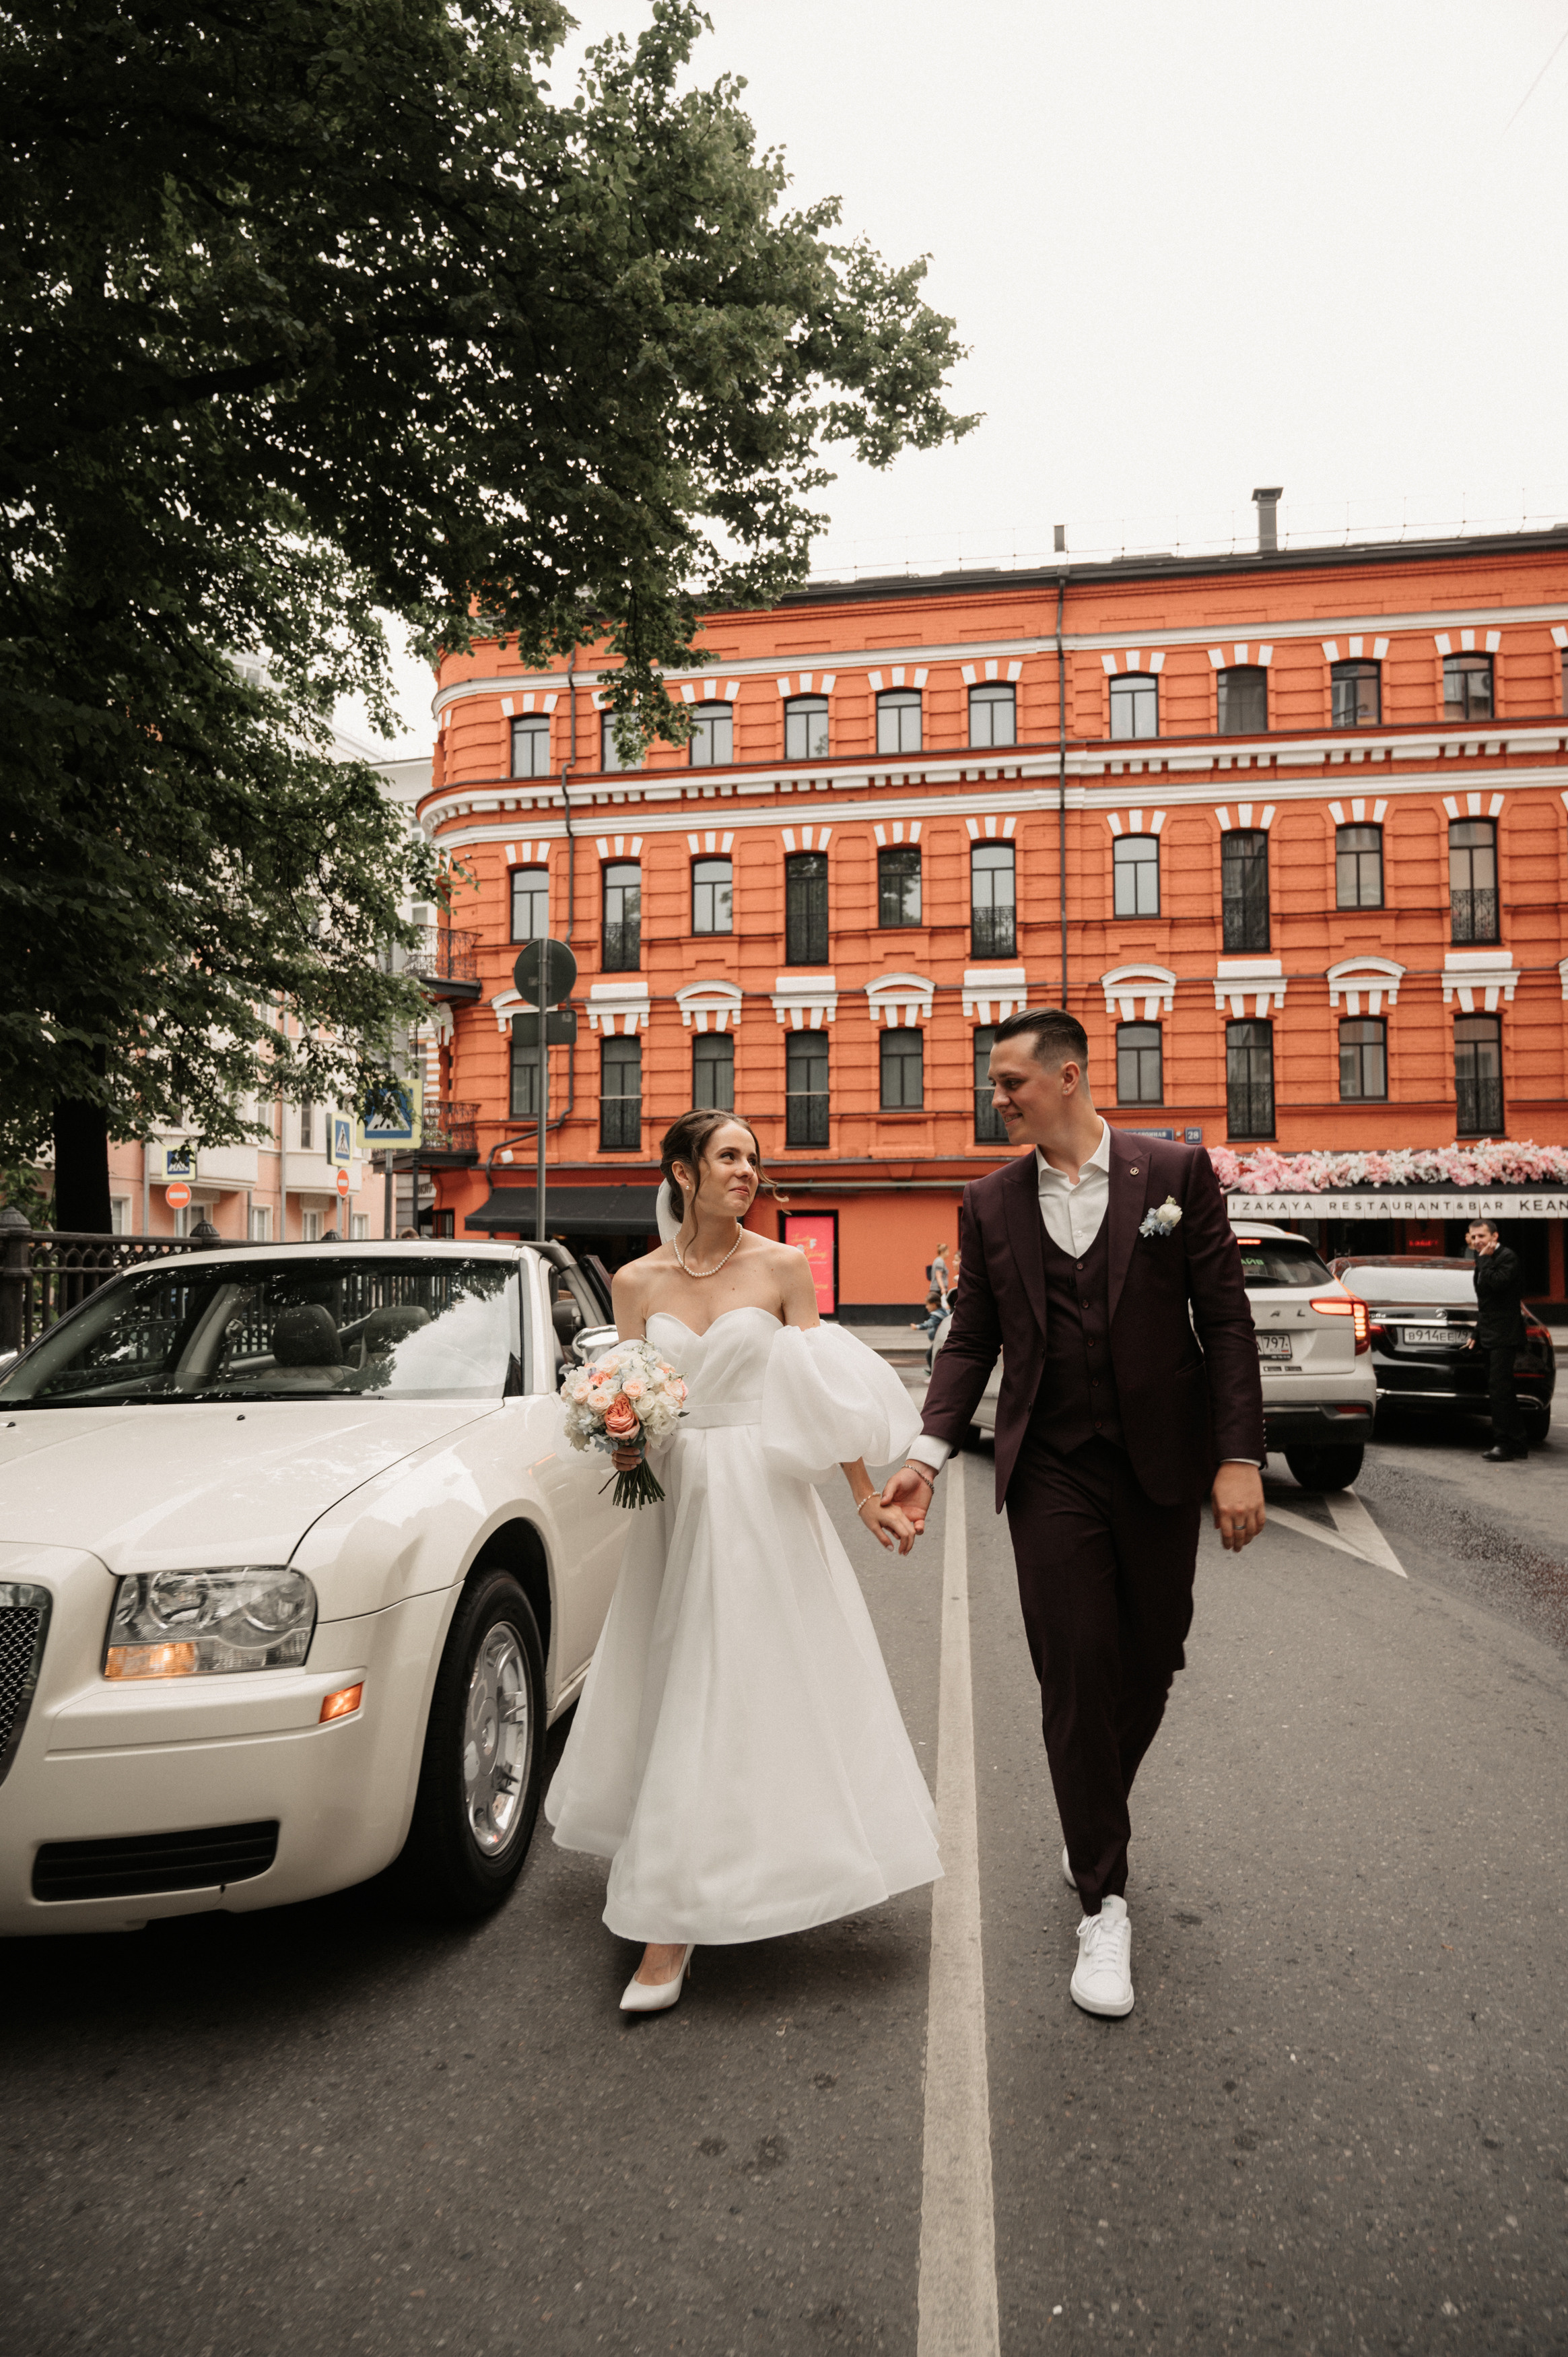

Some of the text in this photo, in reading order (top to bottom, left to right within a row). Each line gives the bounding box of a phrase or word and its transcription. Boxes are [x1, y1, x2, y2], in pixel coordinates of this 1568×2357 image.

[1188, 1131, 1199, 1140] 28
[1232, 1202, 1312, 1211] IZAKAYA
[1519, 1199, 1568, 1211] KEAN
[1263, 1336, 1285, 1349] 797
